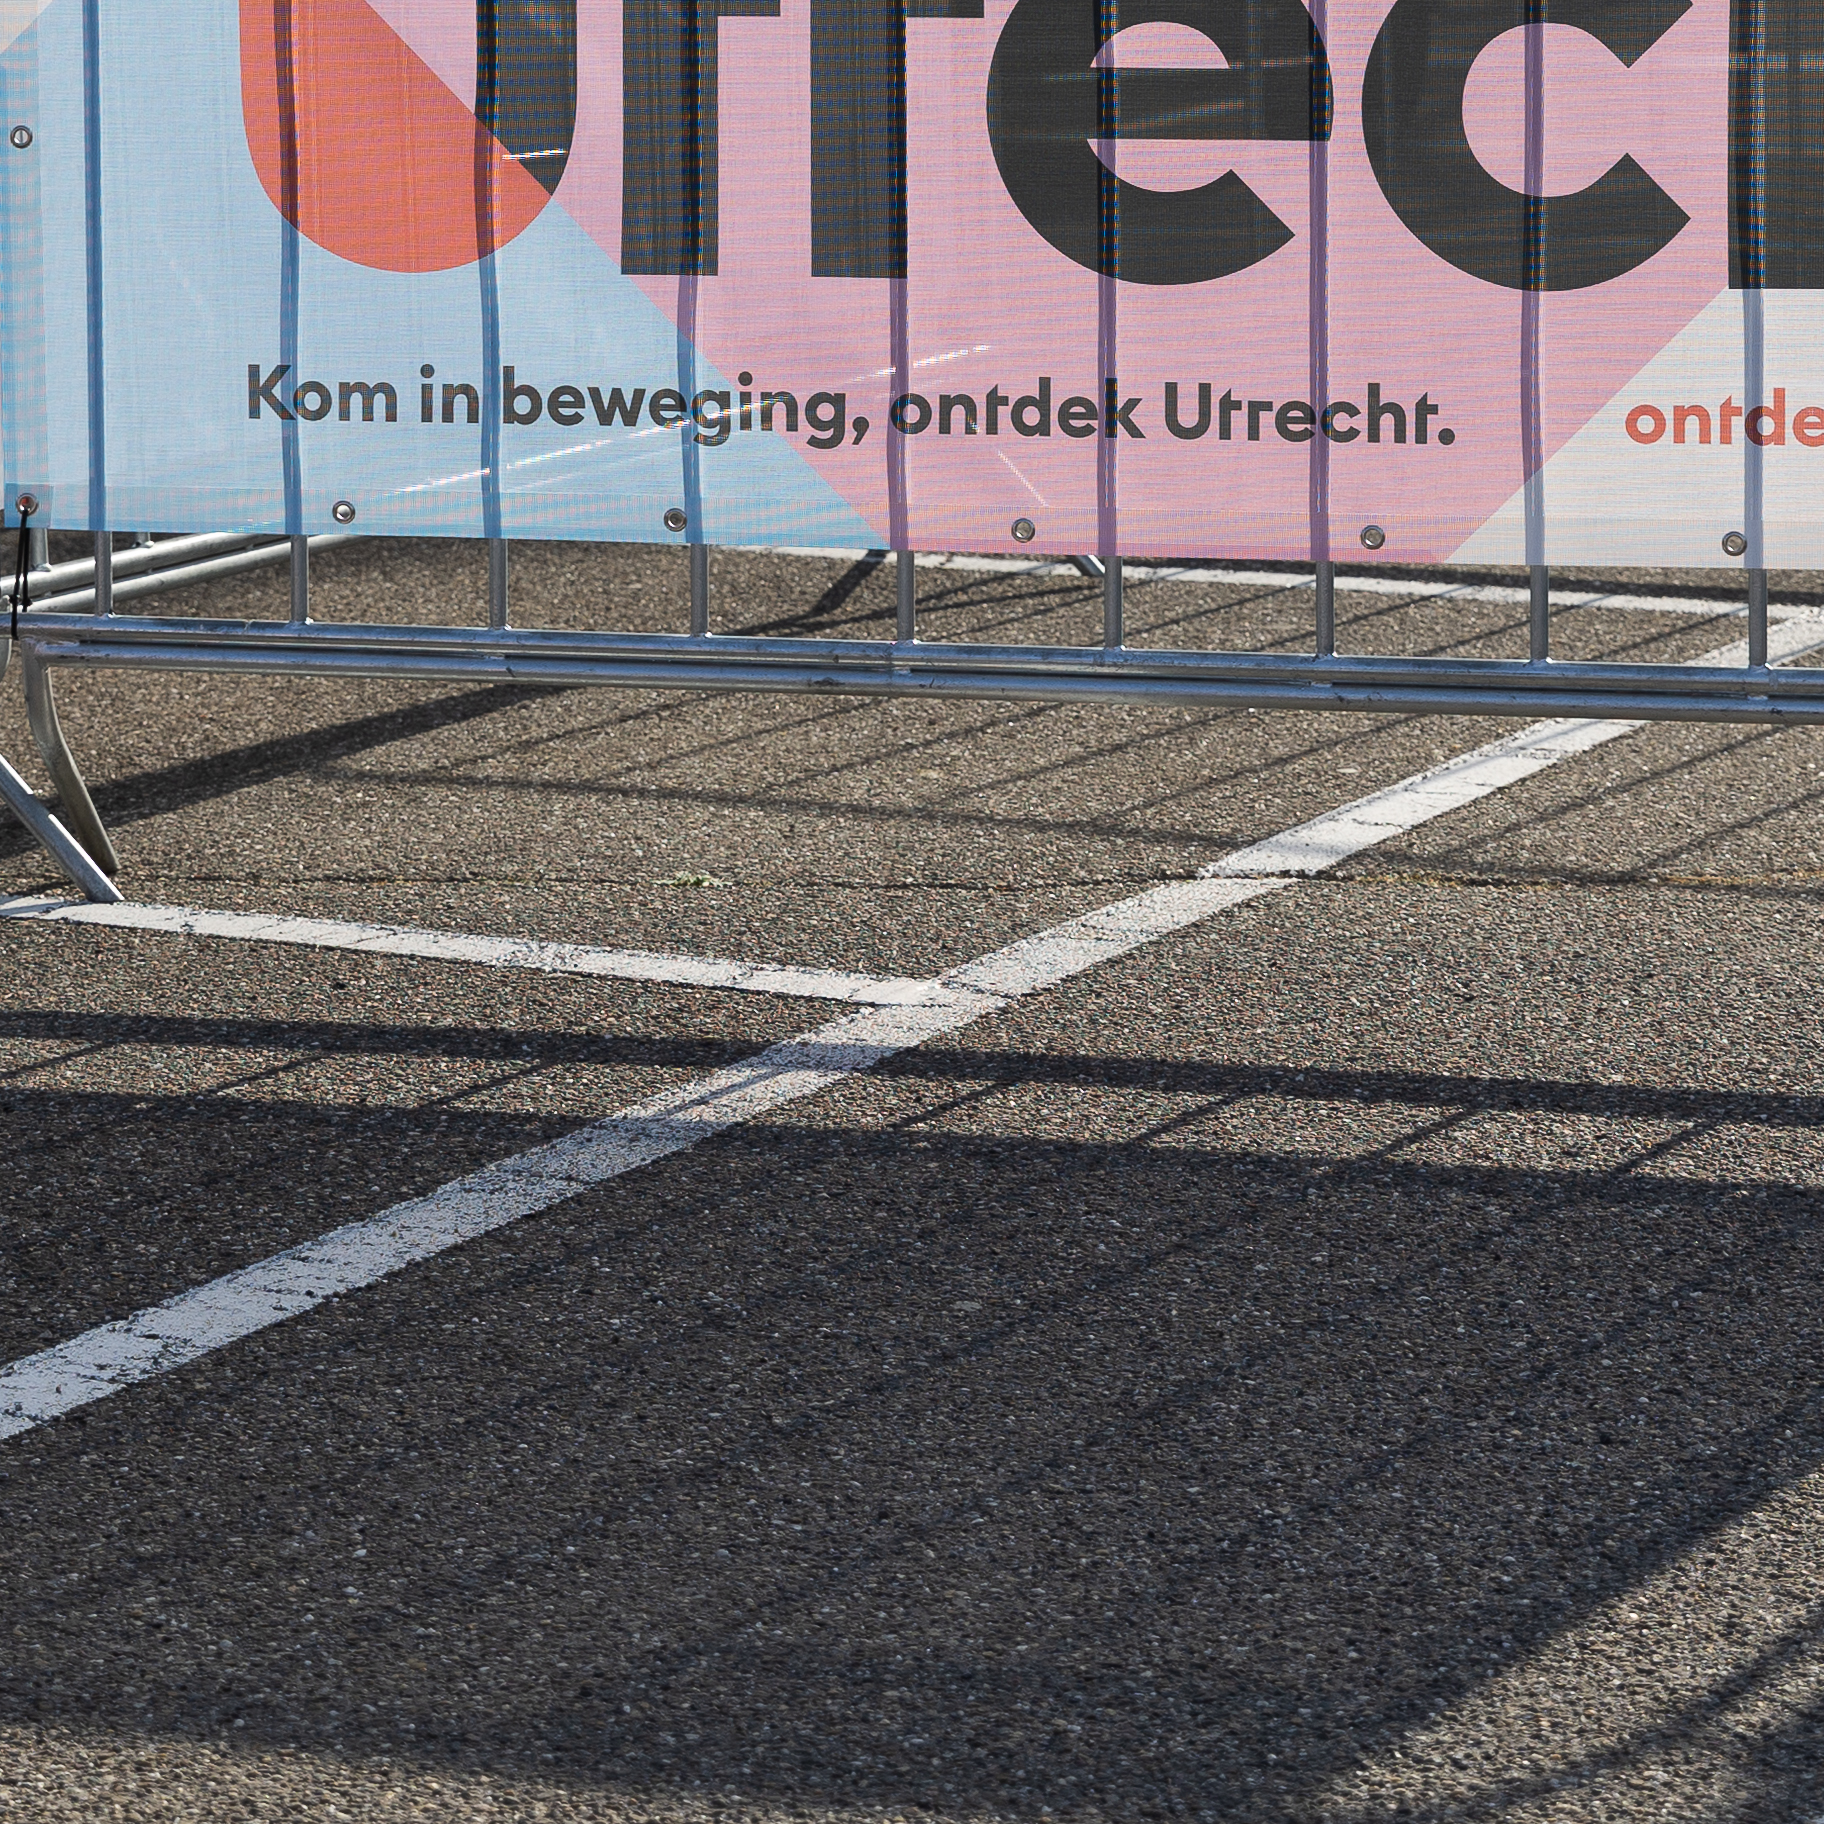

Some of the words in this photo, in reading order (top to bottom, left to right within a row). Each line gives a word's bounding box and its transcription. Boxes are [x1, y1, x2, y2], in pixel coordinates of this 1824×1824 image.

[247, 363, 398, 422] Kom
[420, 363, 480, 423] in
[502, 364, 870, 450] beweging,
[889, 376, 1147, 439] ontdek
[1164, 381, 1457, 446] Utrecht.
